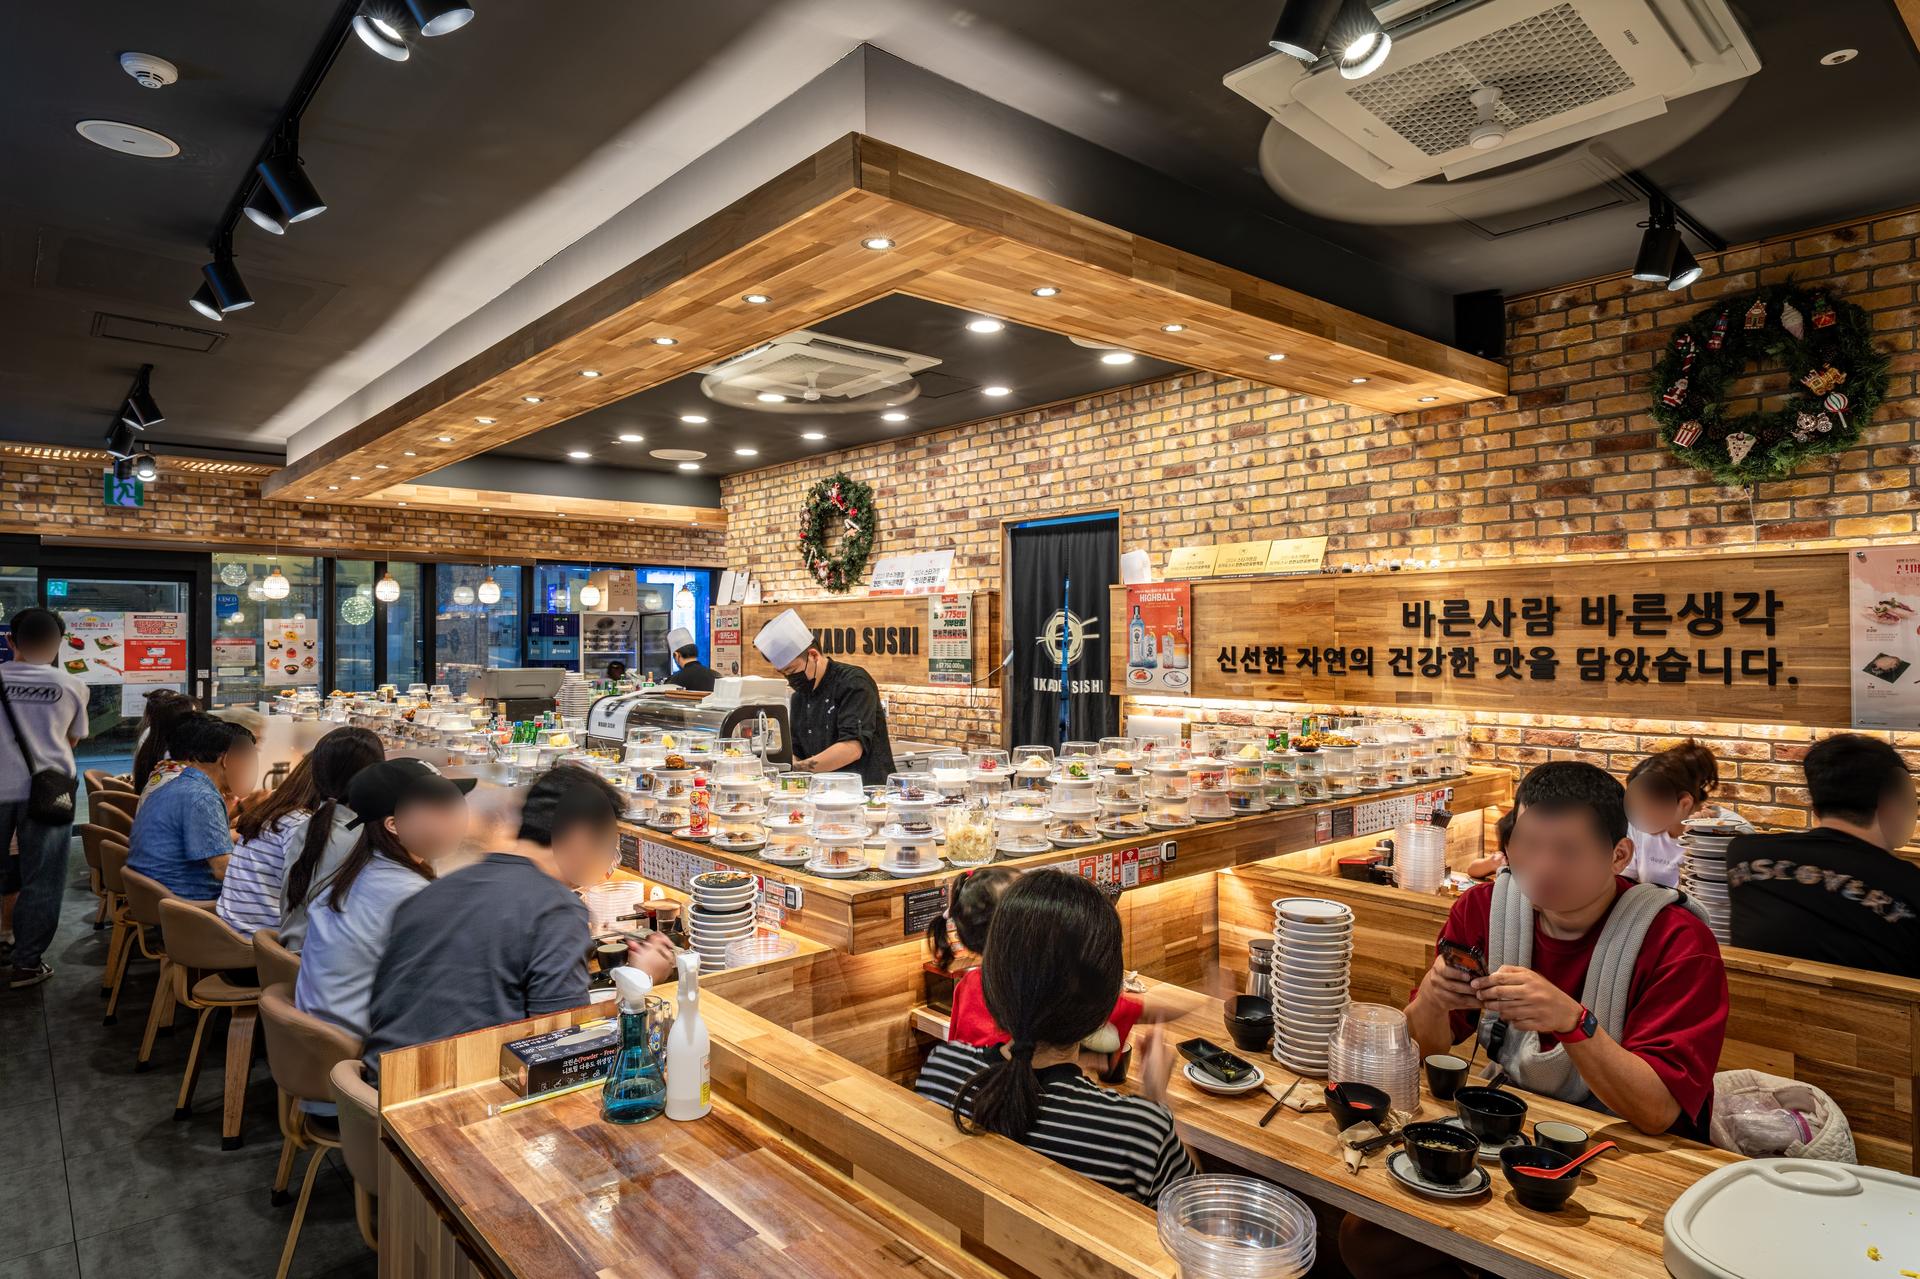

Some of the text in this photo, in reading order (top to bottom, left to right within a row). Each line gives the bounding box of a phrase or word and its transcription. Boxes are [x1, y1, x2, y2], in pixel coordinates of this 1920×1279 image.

[1139, 593, 1176, 603] HIGHBALL
[1401, 590, 1783, 638] 바른사람 바른생각
[808, 627, 856, 655] KADO
[862, 626, 919, 655] SUSHI
[1216, 646, 1799, 686] 신선한 자연의 건강한 맛을 담았습니다.
[579, 1061, 596, 1071] 다용도
